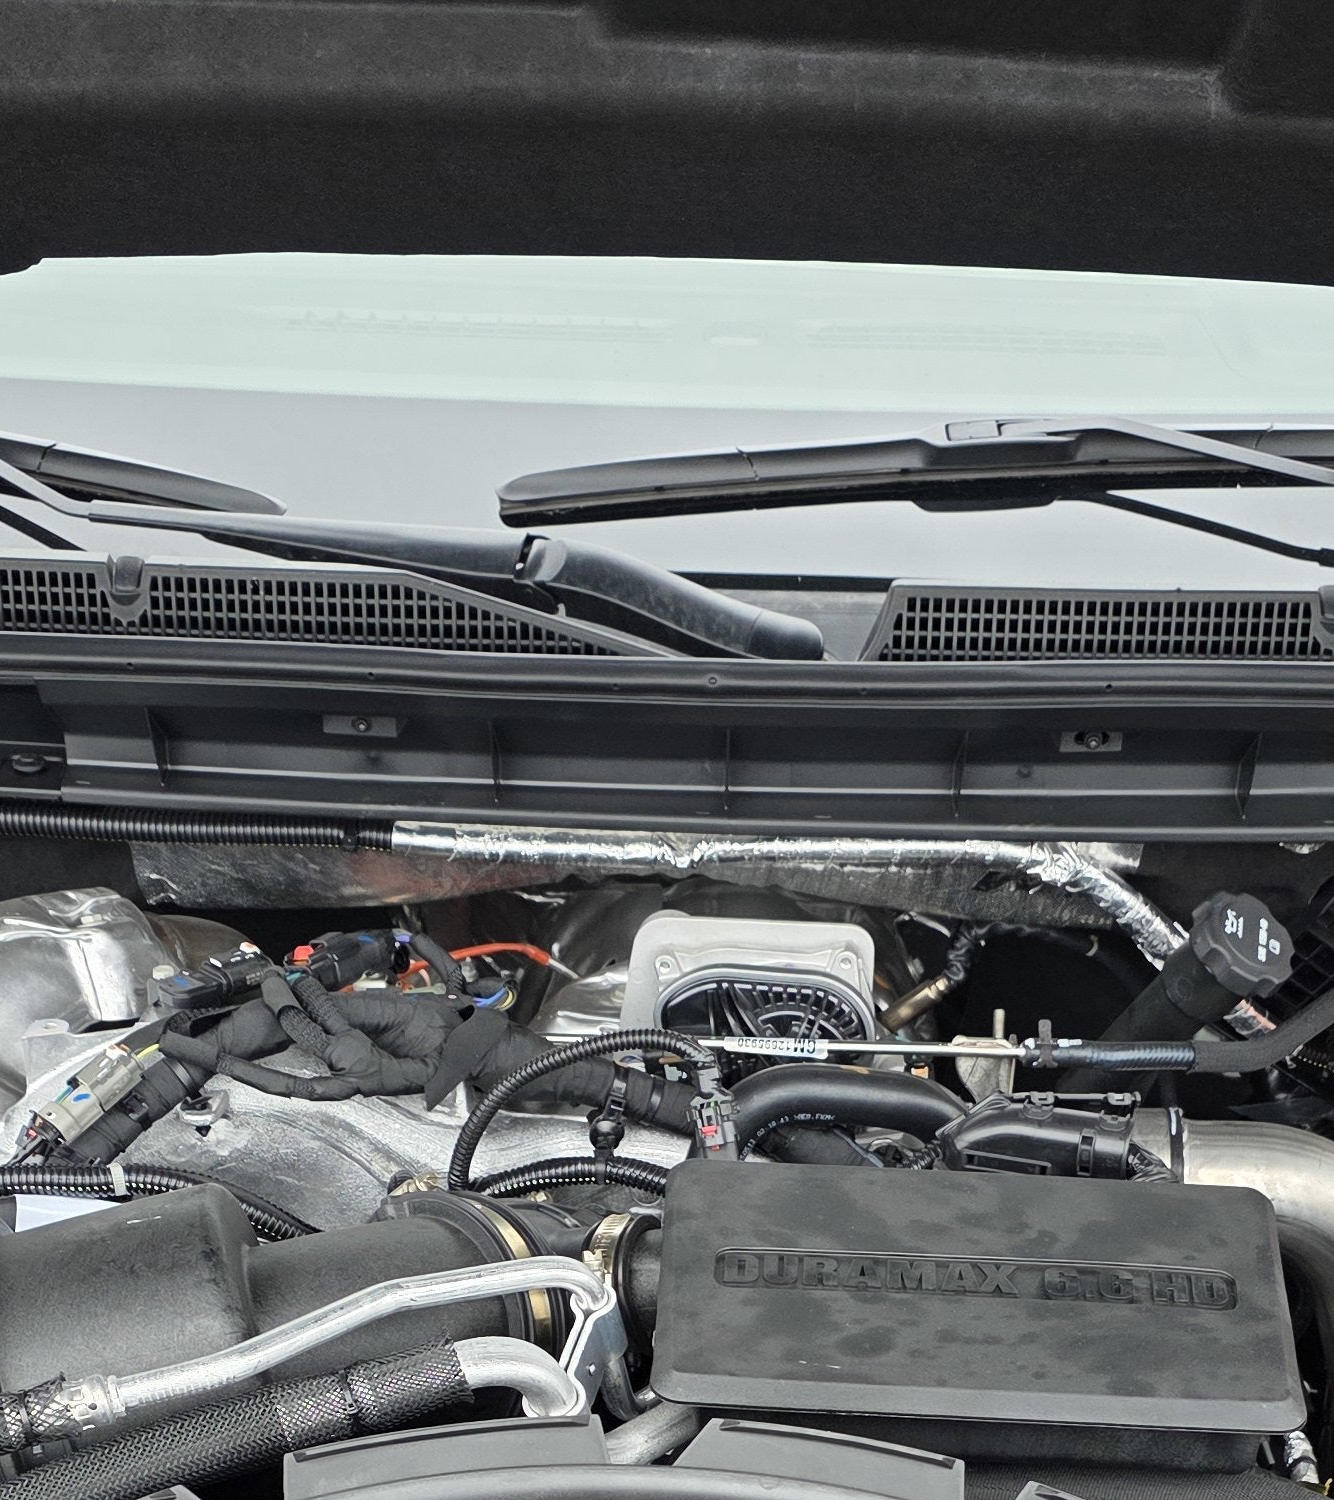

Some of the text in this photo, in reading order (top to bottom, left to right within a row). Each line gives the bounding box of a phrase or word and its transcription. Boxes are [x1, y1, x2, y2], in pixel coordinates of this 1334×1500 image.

[793, 1038, 816, 1055] GM
[721, 1252, 1234, 1308] DURAMAX 6.6 HD
